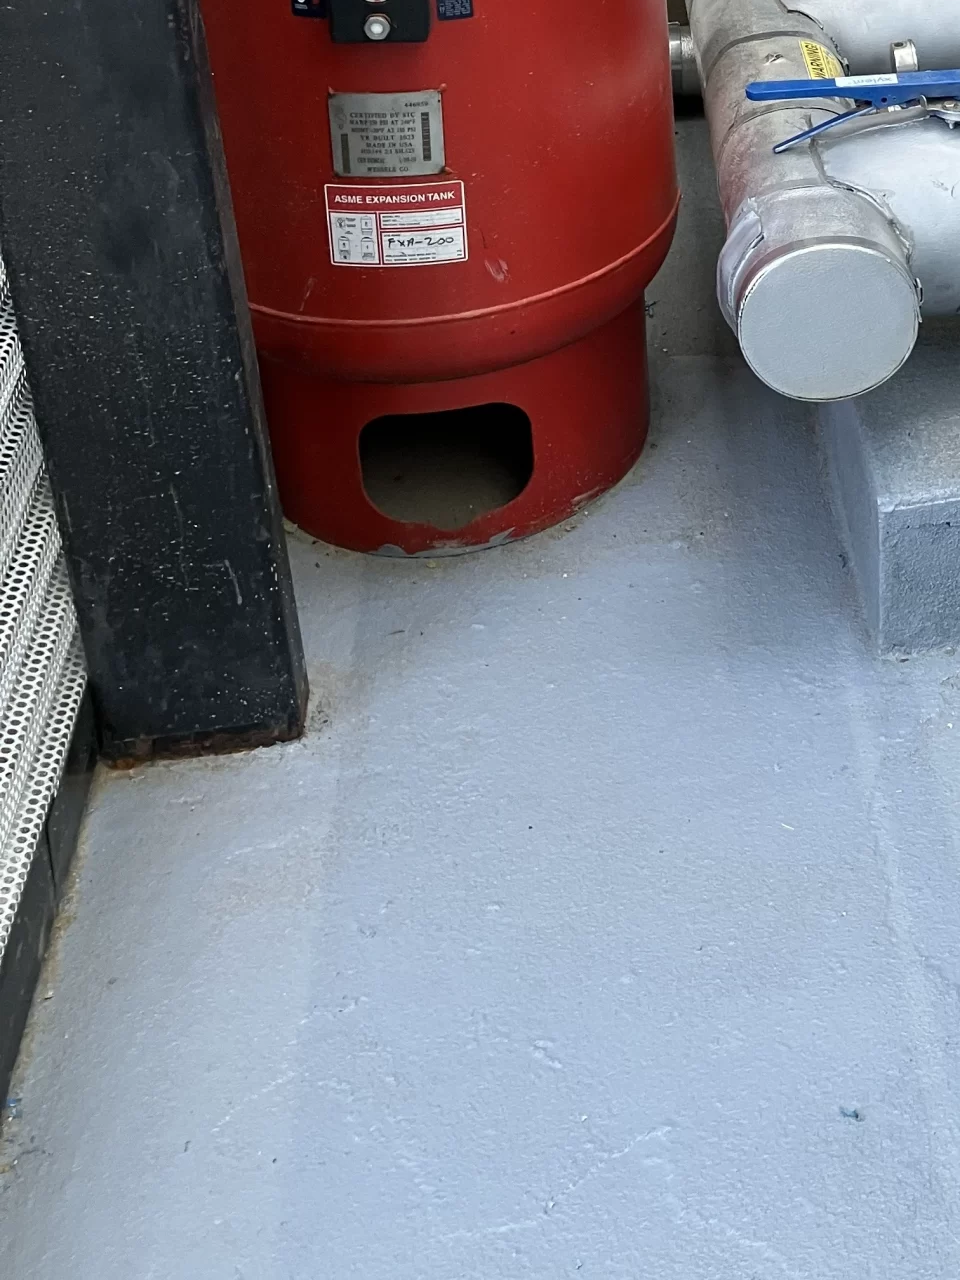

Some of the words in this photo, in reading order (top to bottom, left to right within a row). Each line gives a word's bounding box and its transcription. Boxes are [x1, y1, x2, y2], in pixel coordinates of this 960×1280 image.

[334, 195, 364, 204] ASME
[366, 193, 426, 204] EXPANSION
[427, 191, 455, 201] TANK
